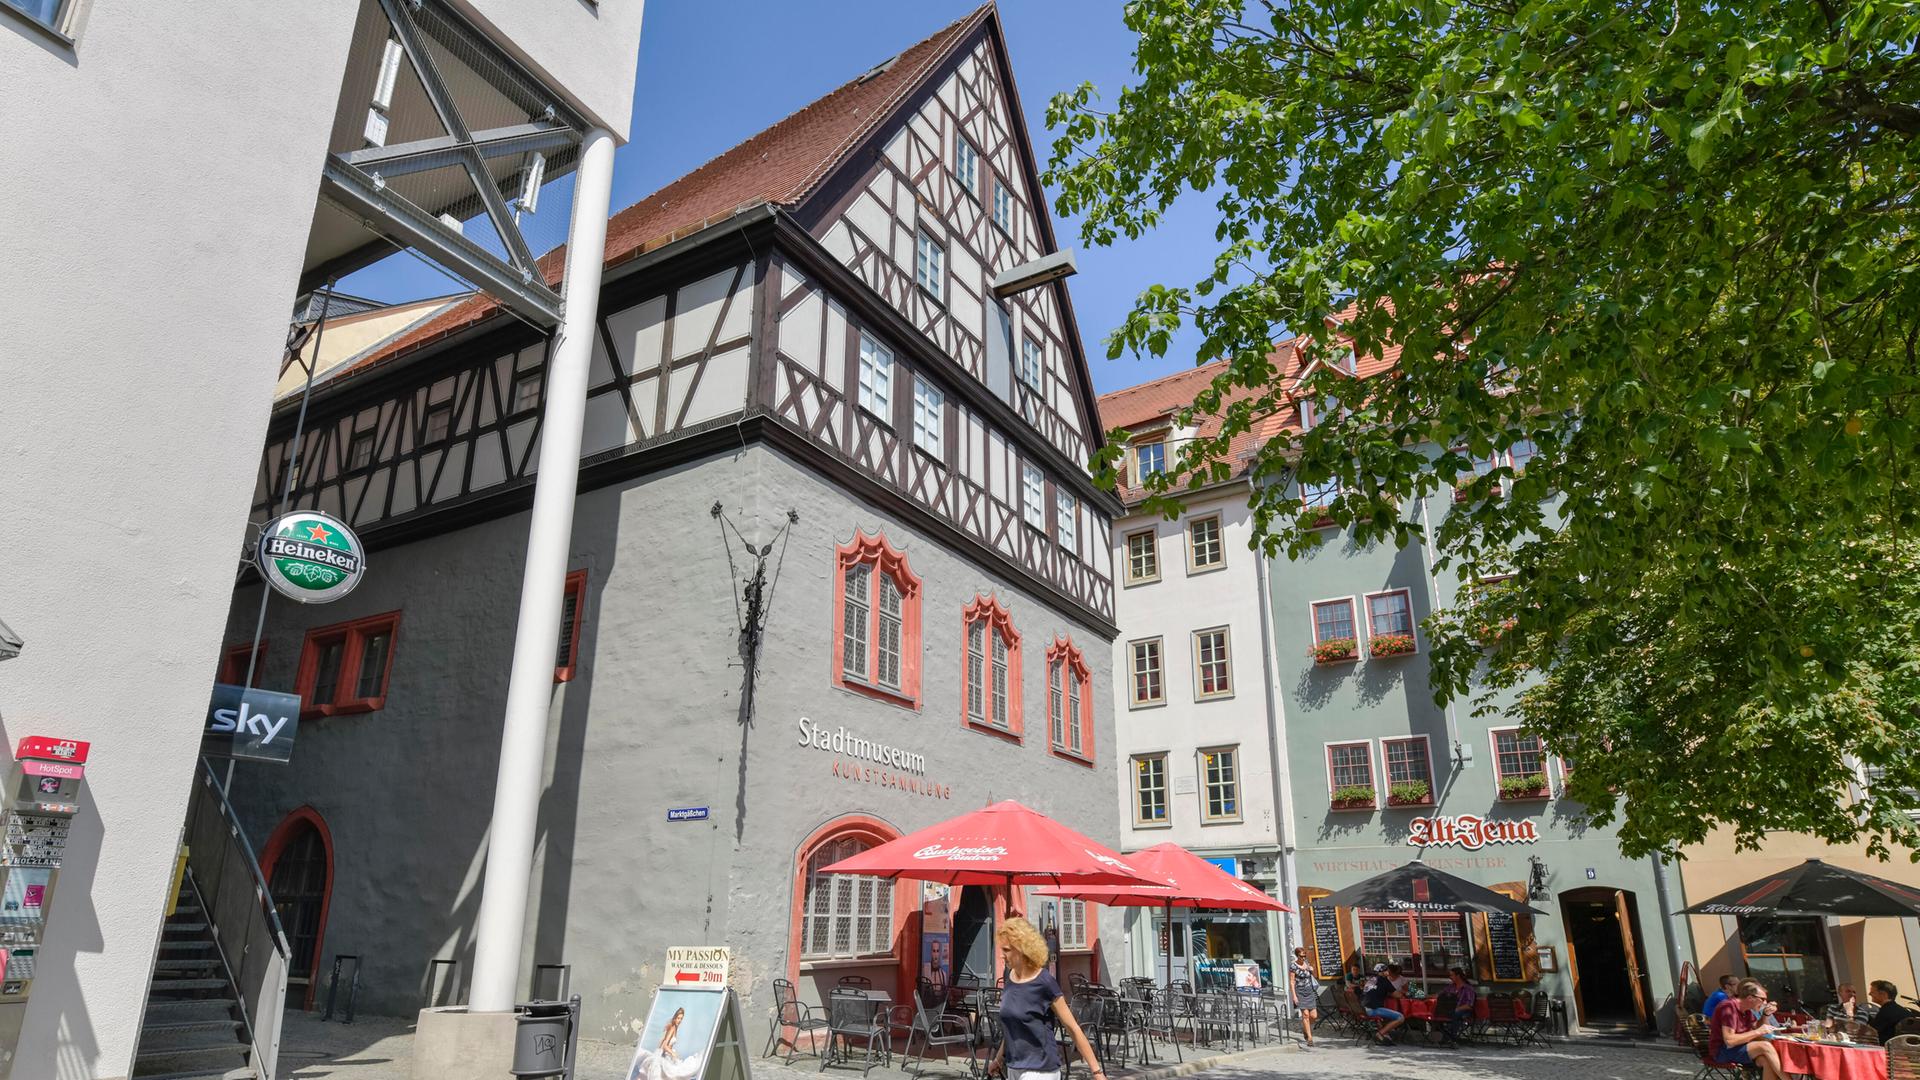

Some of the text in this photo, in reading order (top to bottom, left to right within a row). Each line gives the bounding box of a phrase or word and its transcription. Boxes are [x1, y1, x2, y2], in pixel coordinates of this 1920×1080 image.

[269, 539, 356, 571] Heineken
[211, 702, 288, 744] sky
[798, 716, 926, 774] Stadtmuseum
[40, 763, 73, 775] HotSpot
[832, 757, 951, 800] KUNSTSAMMLUNG
[1408, 813, 1541, 851] Alt Jena
[913, 844, 1009, 860] Budweiser
[1313, 858, 1507, 872] WIRTSHAUS EINSTUBE
[668, 948, 730, 962] MY PASSION
[703, 970, 723, 983] 20m
